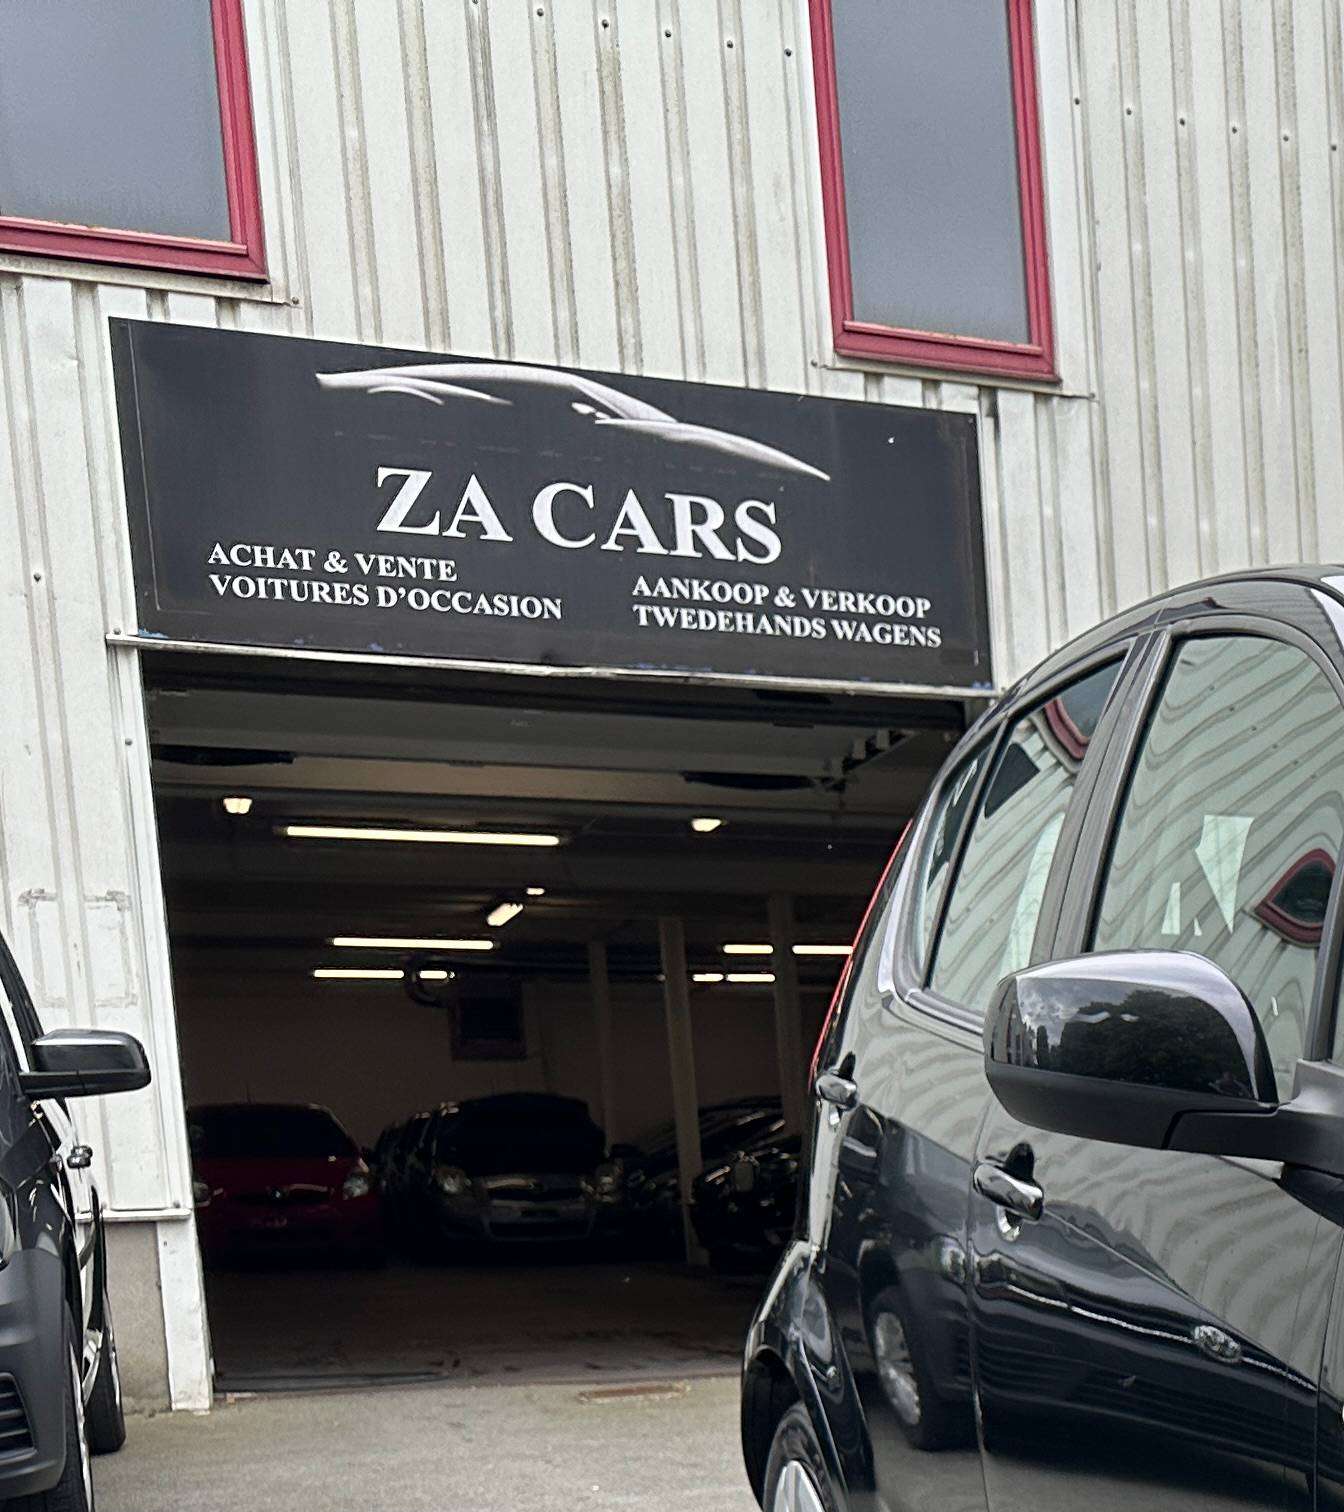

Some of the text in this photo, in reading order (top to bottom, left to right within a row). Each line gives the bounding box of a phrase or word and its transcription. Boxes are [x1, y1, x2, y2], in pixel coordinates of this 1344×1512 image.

[376, 466, 783, 565] ZA CARS
[207, 542, 458, 582] ACHAT & VENTE
[208, 574, 370, 606] VOITURES
[631, 575, 932, 619] AANKOOP & VERKOOP
[632, 604, 942, 648] TWEDEHANDS WAGENS
